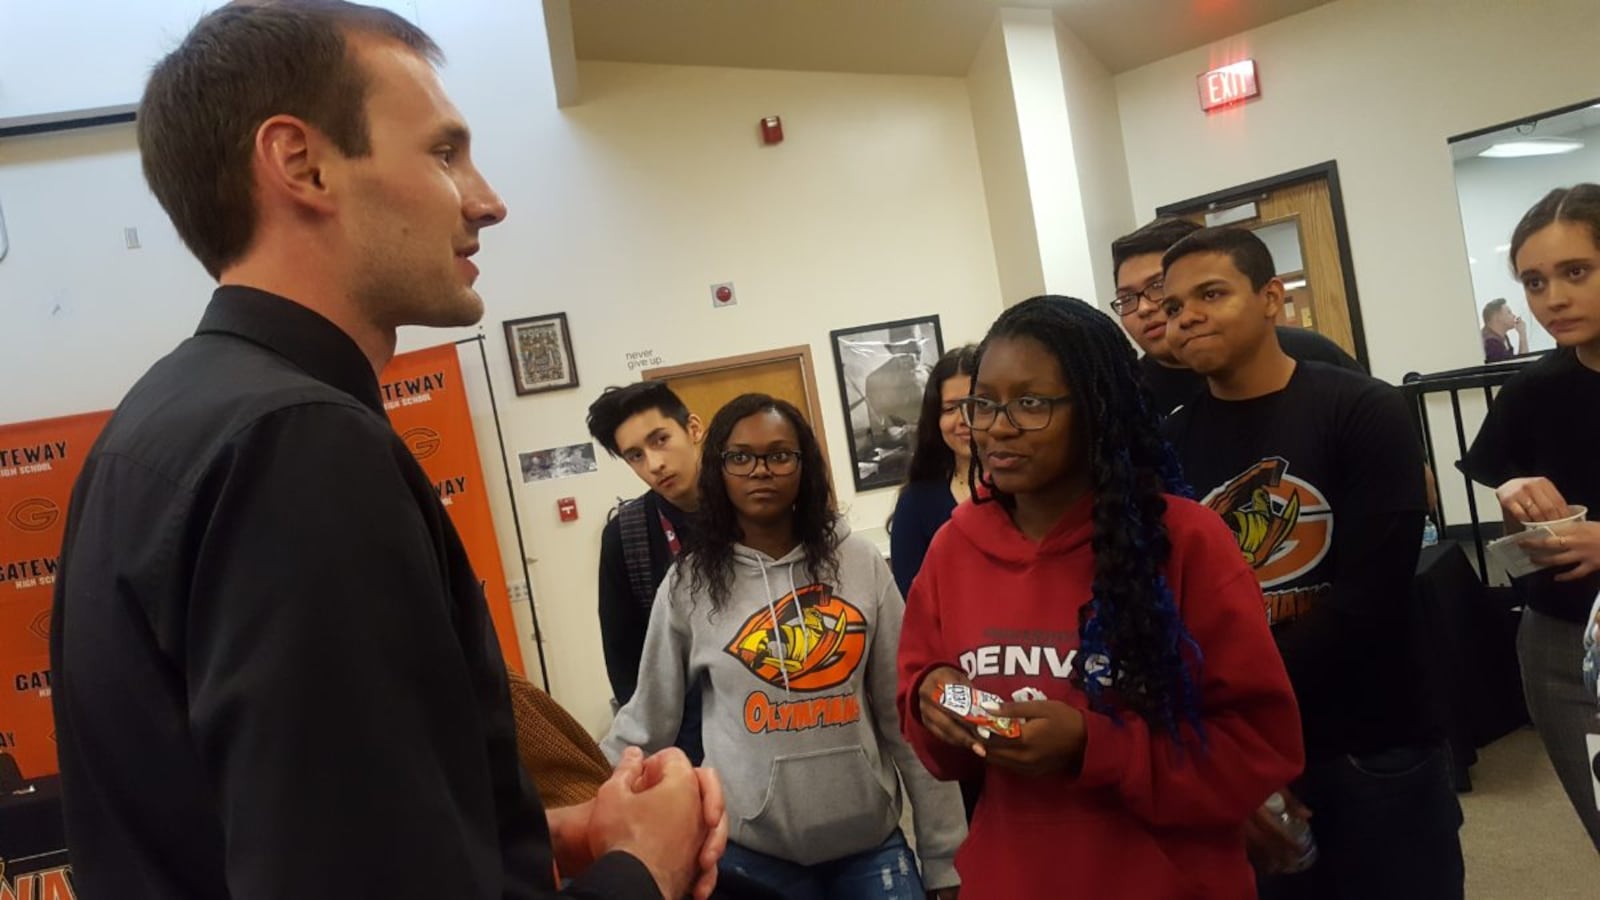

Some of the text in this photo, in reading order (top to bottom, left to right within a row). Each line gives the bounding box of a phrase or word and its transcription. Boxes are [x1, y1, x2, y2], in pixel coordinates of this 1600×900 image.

[1208, 67, 1250, 104] EXIT
[625, 349, 653, 360] never
[627, 359, 648, 371] give
[382, 372, 444, 401] TEWAY
[0, 440, 66, 467] TEWAY
[20, 463, 52, 475] SCHOOL
